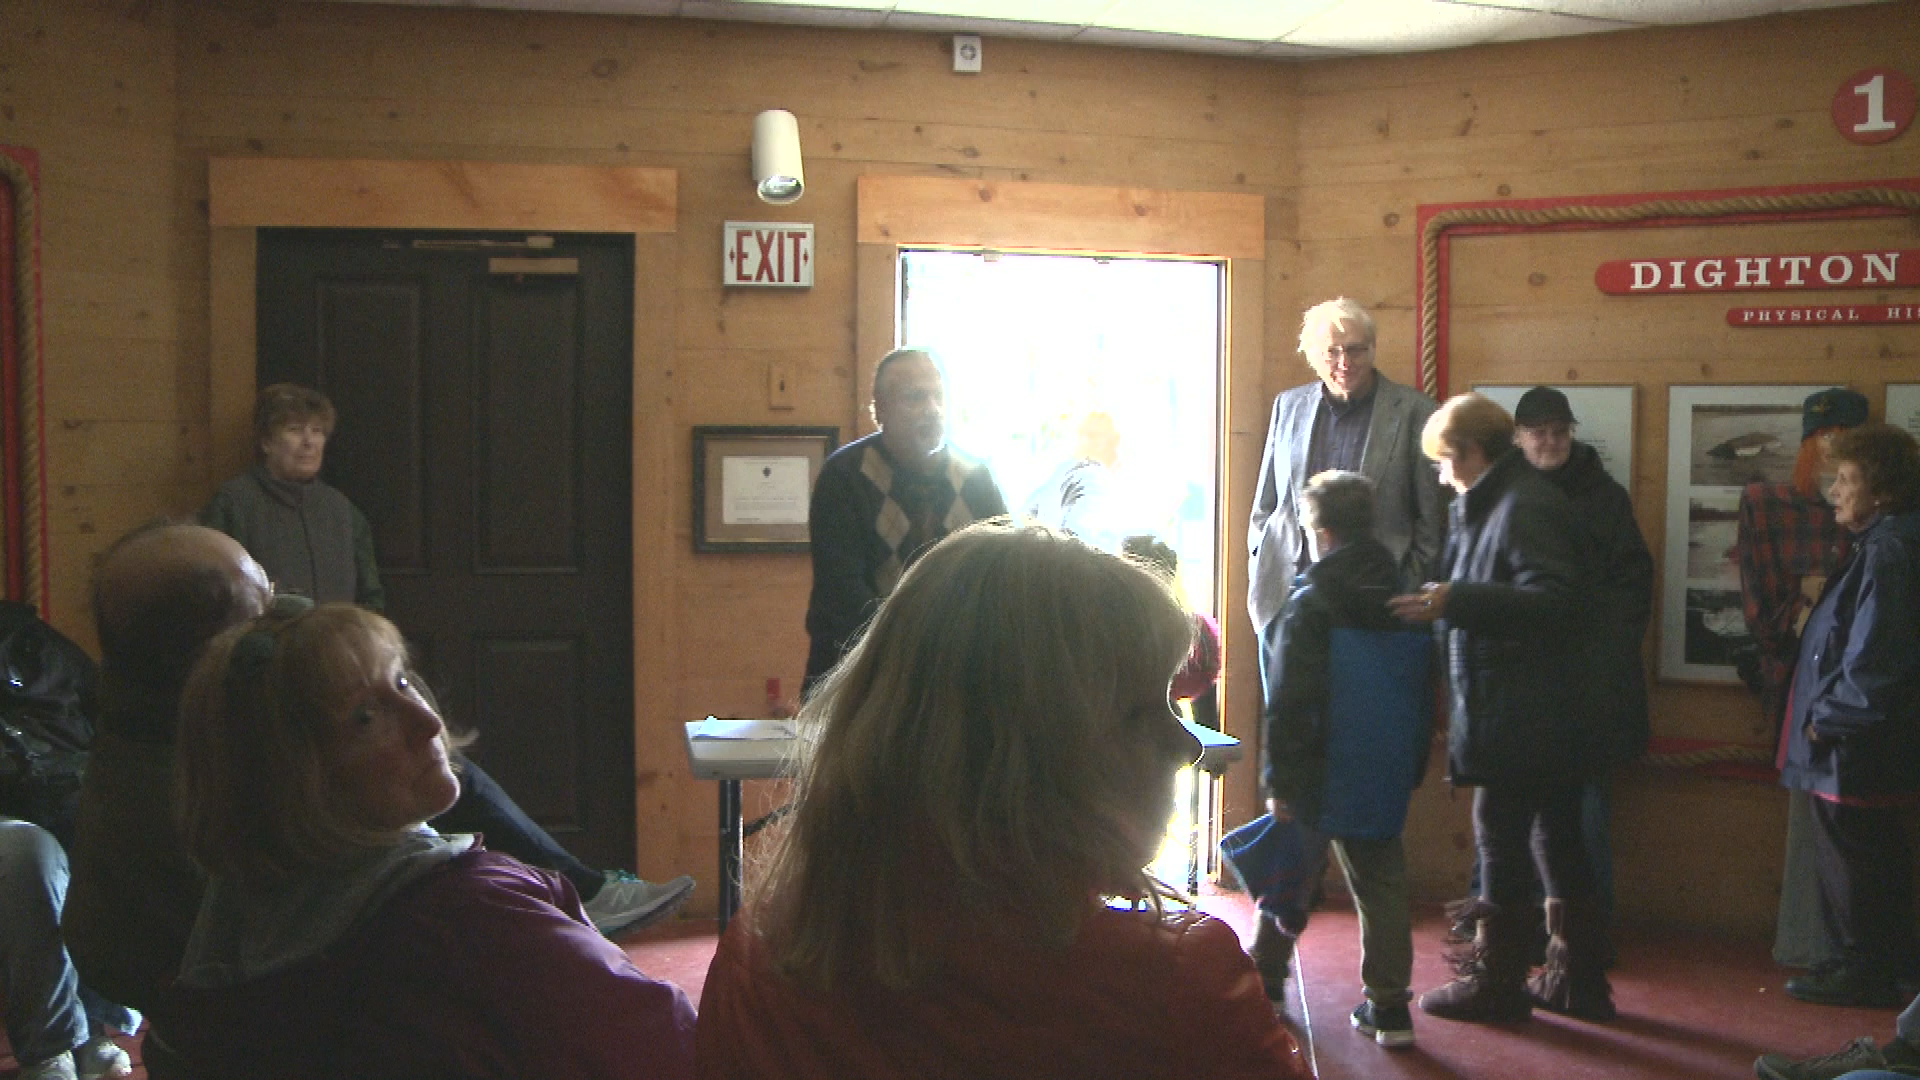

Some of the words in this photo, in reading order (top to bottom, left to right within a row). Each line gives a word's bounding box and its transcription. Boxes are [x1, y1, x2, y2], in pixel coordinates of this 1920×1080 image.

[1854, 75, 1896, 133] 1
[736, 230, 807, 282] EXIT
[1630, 252, 1900, 290] DIGHTON
[1743, 309, 1859, 322] PHYSICAL
[1887, 307, 1920, 319] HI
